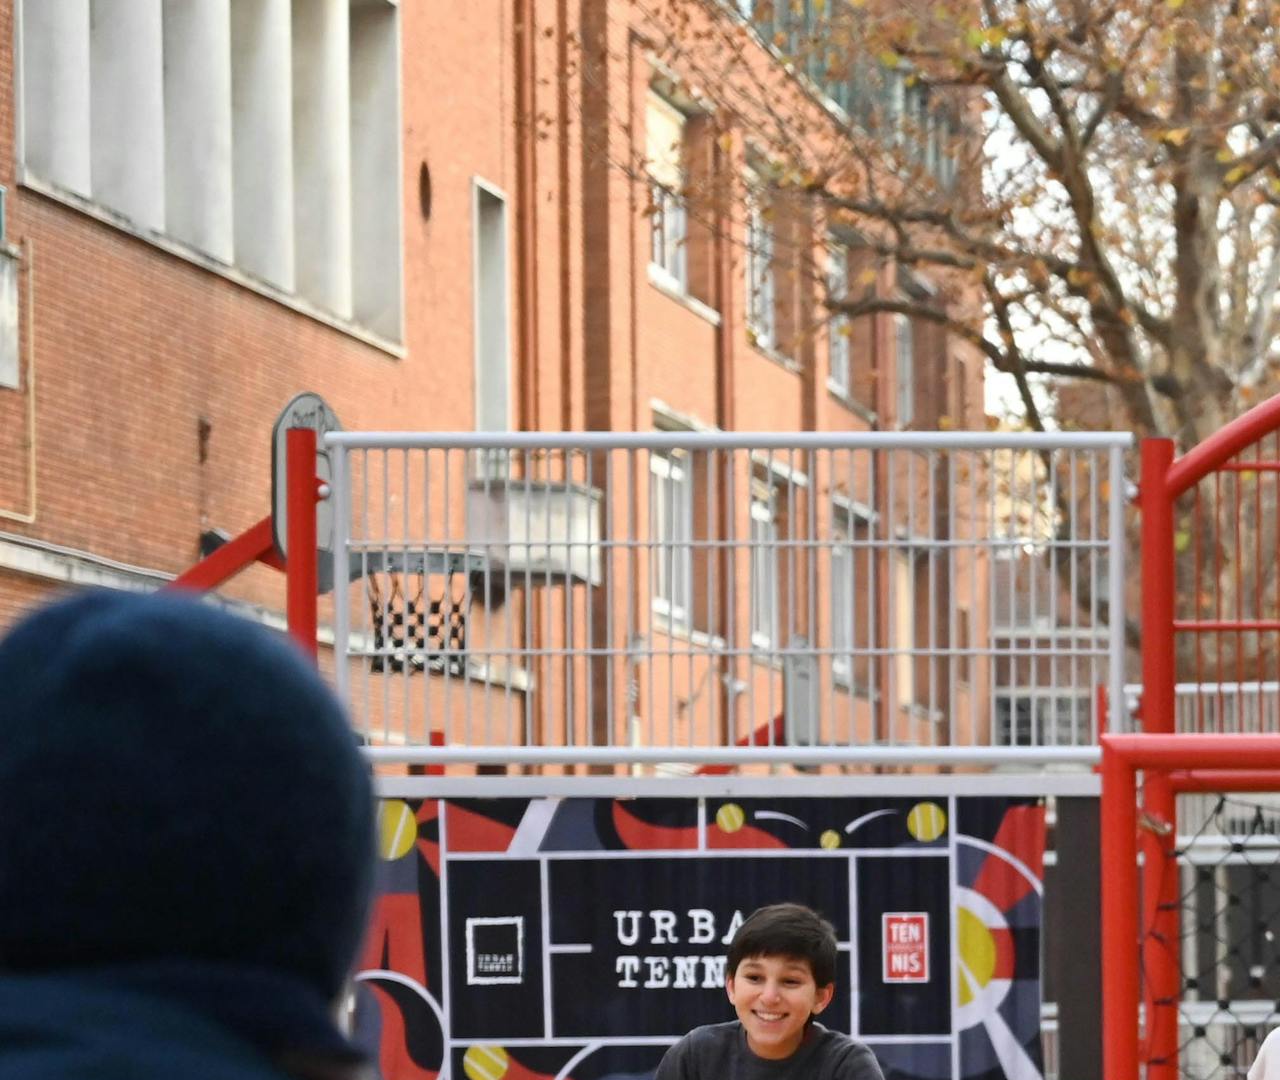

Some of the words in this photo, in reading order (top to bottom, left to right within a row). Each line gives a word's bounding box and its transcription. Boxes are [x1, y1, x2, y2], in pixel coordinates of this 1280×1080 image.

[613, 908, 745, 946] URBA
[890, 922, 921, 943] TEN
[615, 955, 728, 989] TENN
[892, 951, 921, 973] NIS
